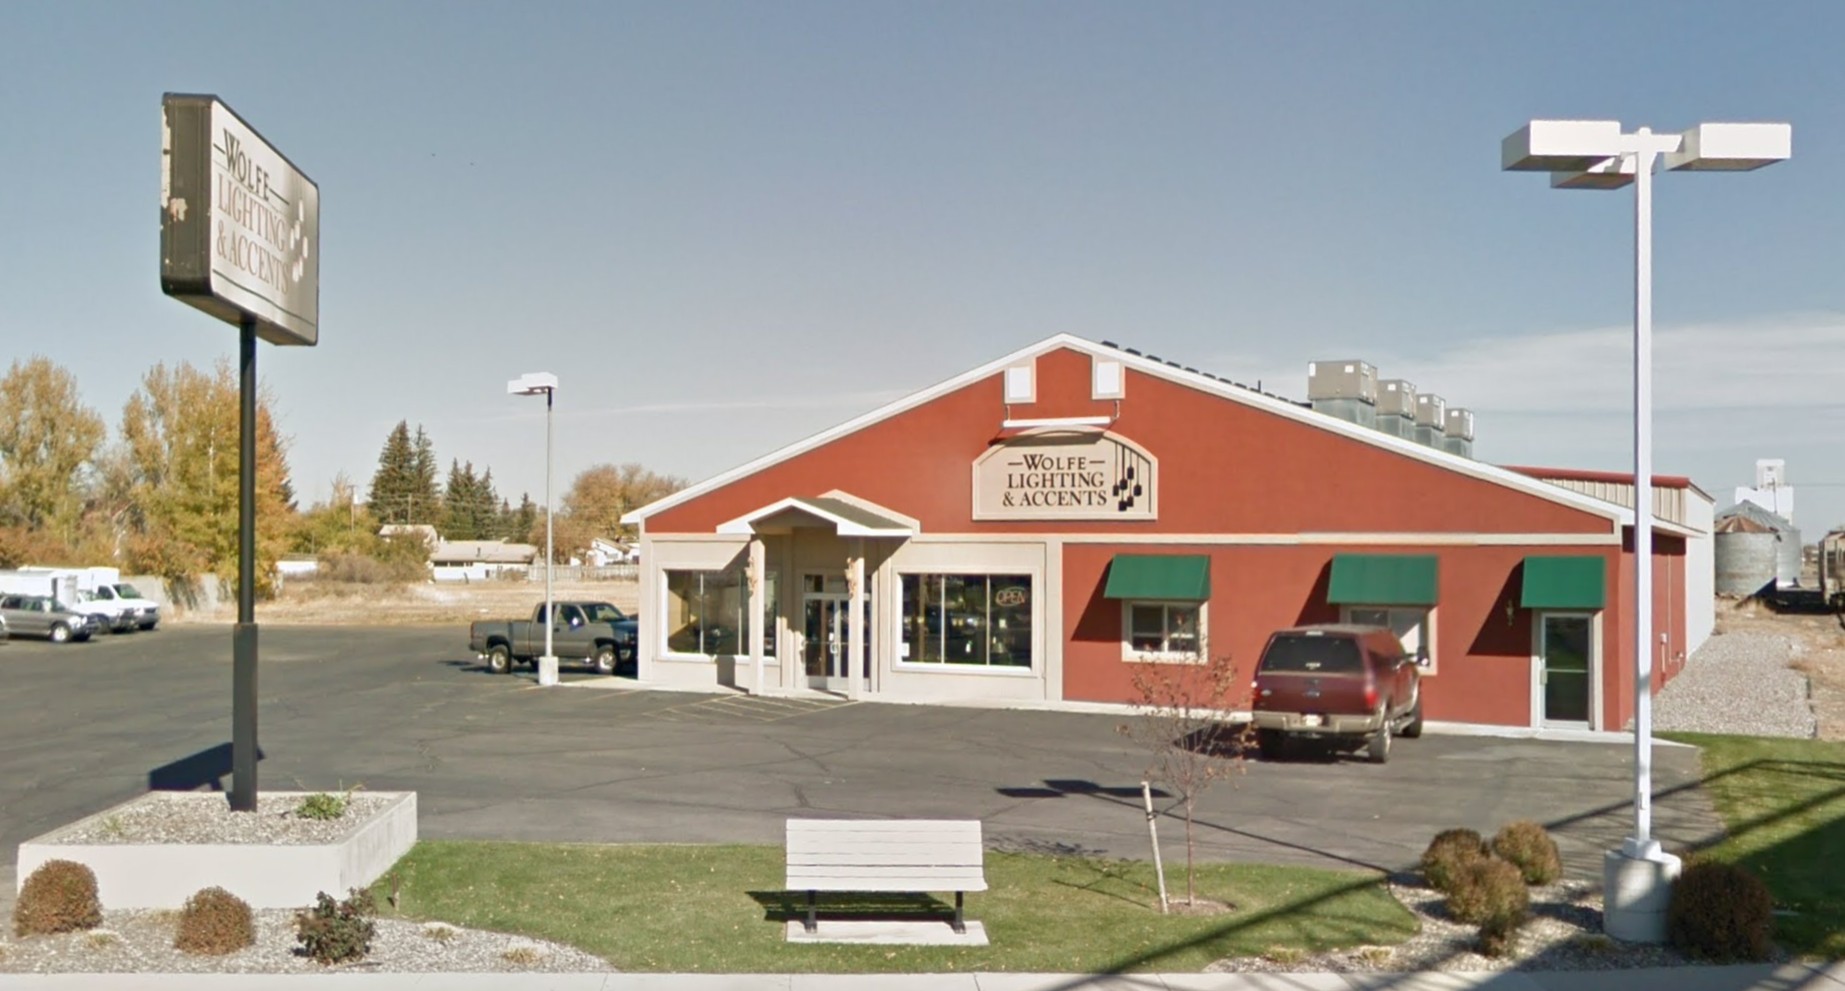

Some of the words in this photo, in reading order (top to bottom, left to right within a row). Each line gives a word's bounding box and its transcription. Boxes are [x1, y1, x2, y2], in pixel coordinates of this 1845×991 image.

[223, 128, 269, 202] WOLFE
[218, 173, 287, 252] LIGHTING
[217, 220, 227, 260] &
[229, 230, 288, 295] ACCENTS
[1022, 454, 1087, 471] WOLFE
[1007, 472, 1105, 489] LIGHTING
[1002, 491, 1015, 507] &
[1019, 490, 1107, 507] ACCENTS
[997, 589, 1025, 604] OPEN
